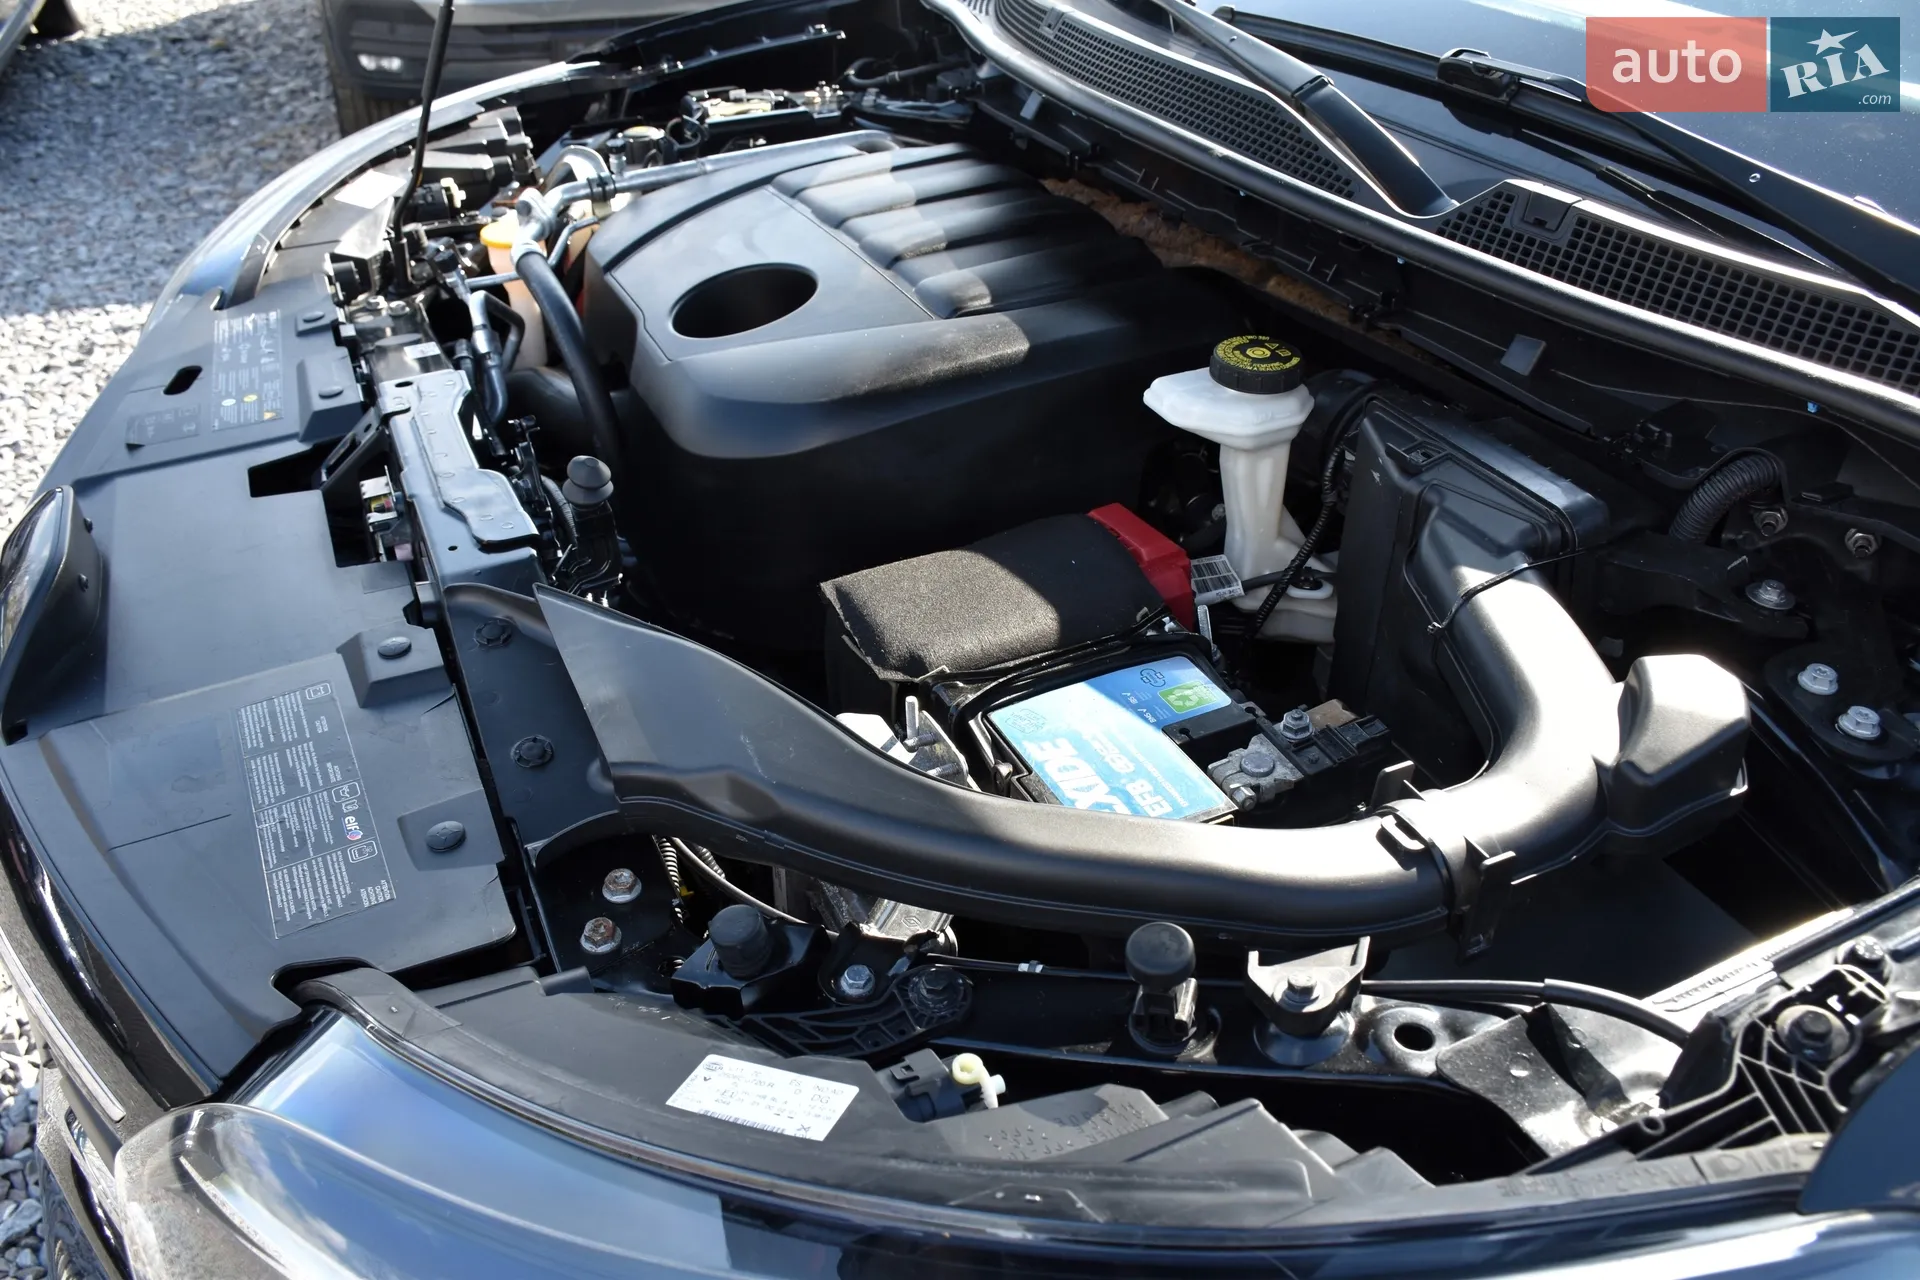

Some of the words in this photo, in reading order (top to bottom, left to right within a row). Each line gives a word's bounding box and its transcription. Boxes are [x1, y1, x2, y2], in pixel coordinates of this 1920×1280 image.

[1021, 737, 1133, 815] XIDE
[1125, 779, 1173, 818] EFB
[343, 814, 359, 833] elf
